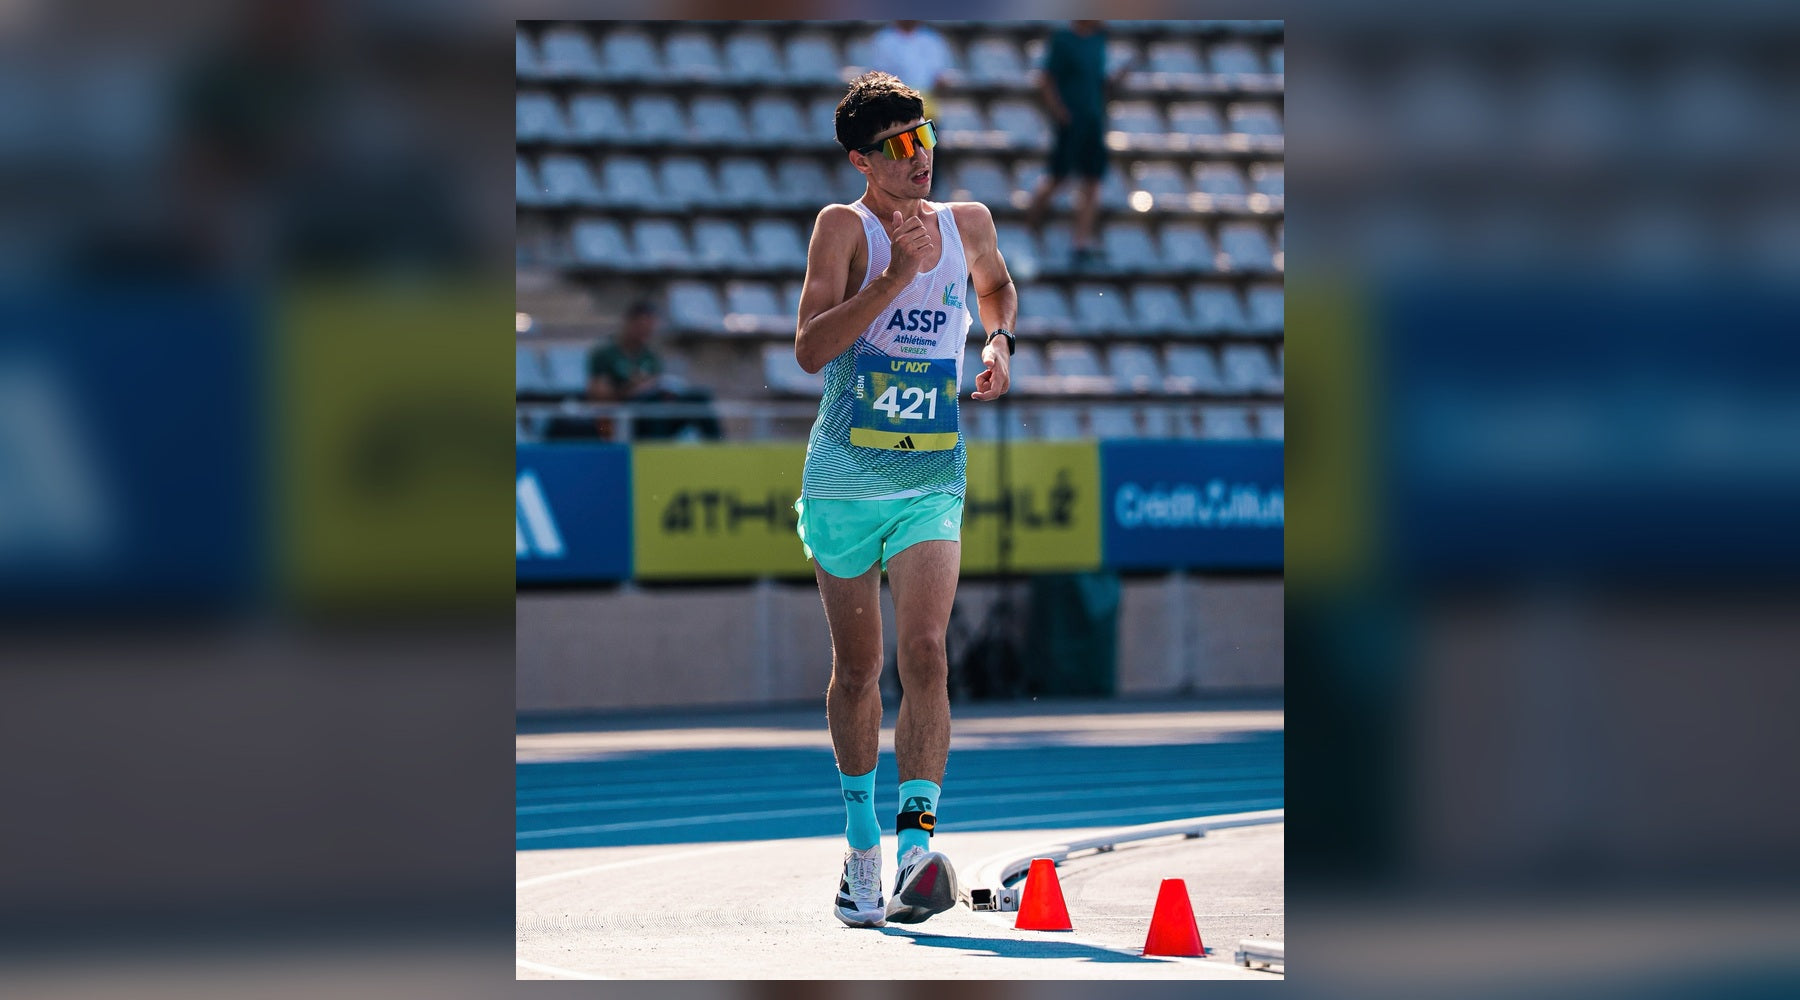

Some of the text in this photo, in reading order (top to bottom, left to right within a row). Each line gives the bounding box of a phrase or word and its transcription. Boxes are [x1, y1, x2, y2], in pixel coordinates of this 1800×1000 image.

[887, 309, 947, 333] ASSP
[893, 334, 937, 347] Athlétisme
[905, 361, 932, 373] NXT
[856, 375, 865, 399] U18M
[873, 386, 938, 420] 421
[661, 489, 798, 533] ATHL
